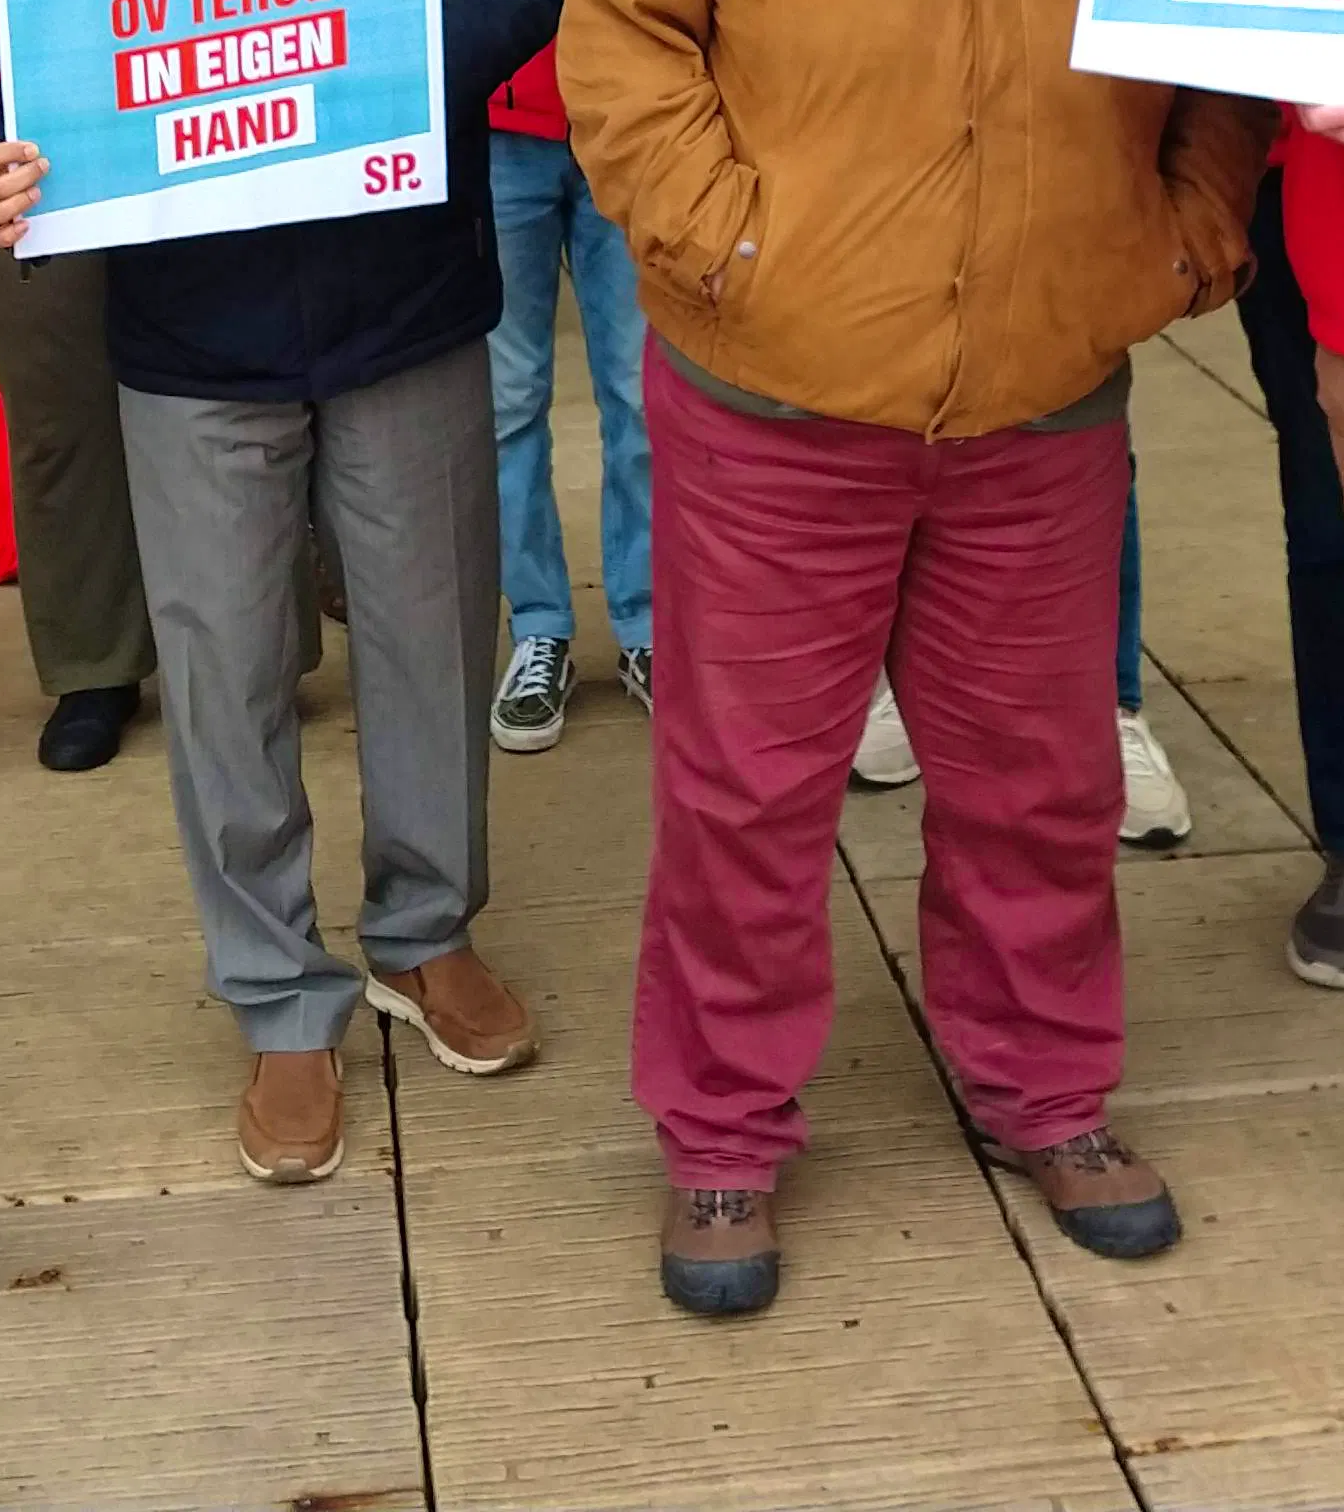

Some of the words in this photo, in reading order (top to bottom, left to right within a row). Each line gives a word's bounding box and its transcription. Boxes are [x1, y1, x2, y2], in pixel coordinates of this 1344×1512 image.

[129, 47, 182, 104] IN
[194, 17, 334, 90] EIGEN
[174, 96, 298, 163] HAND
